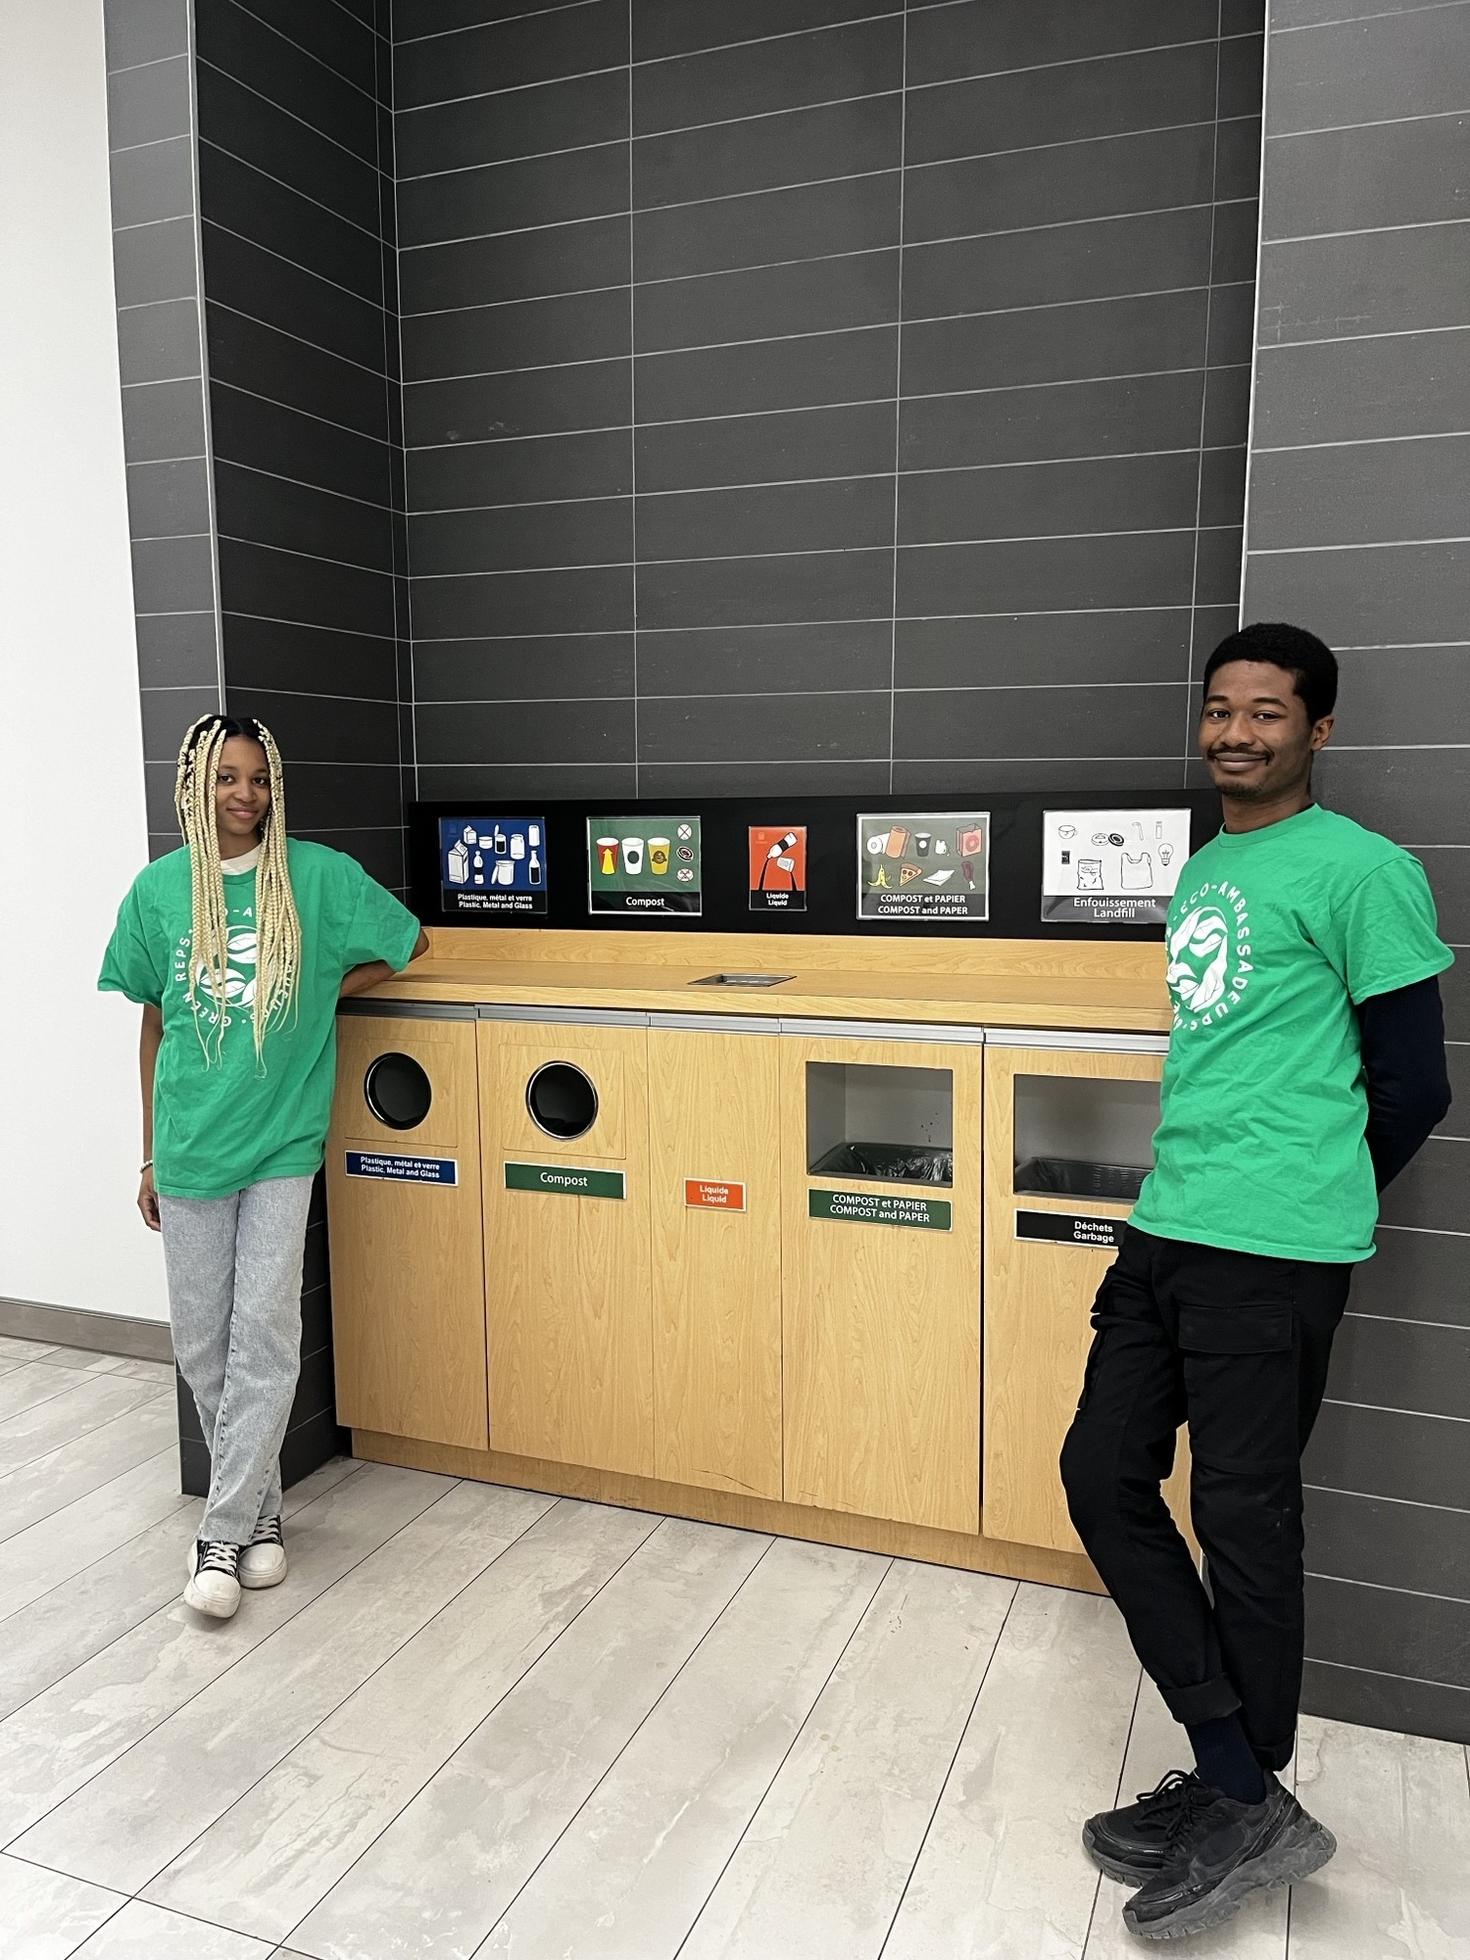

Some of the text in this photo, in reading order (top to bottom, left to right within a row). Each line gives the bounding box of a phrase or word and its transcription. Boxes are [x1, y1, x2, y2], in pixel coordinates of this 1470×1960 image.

[626, 896, 665, 906] Compost
[766, 892, 789, 900] Liquide
[880, 894, 922, 903] COMPOST
[934, 895, 966, 903] PAPIER
[1073, 897, 1156, 907] Enfouissement
[877, 905, 968, 915] COMPOST and PAPER
[1093, 907, 1135, 918] Landfill
[175, 937, 191, 982] REPS
[394, 1160, 413, 1168] métal
[386, 1167, 405, 1175] Metal
[420, 1170, 440, 1178] Glass
[540, 1172, 588, 1187] Compost
[700, 1185, 729, 1195] Liquide
[702, 1194, 727, 1204] Liquid
[832, 1194, 927, 1211] COMPOST et PAPIER
[829, 1204, 930, 1223] COMPOST and PAPER
[1074, 1220, 1113, 1233] Déchets
[1073, 1231, 1114, 1244] Garbage
